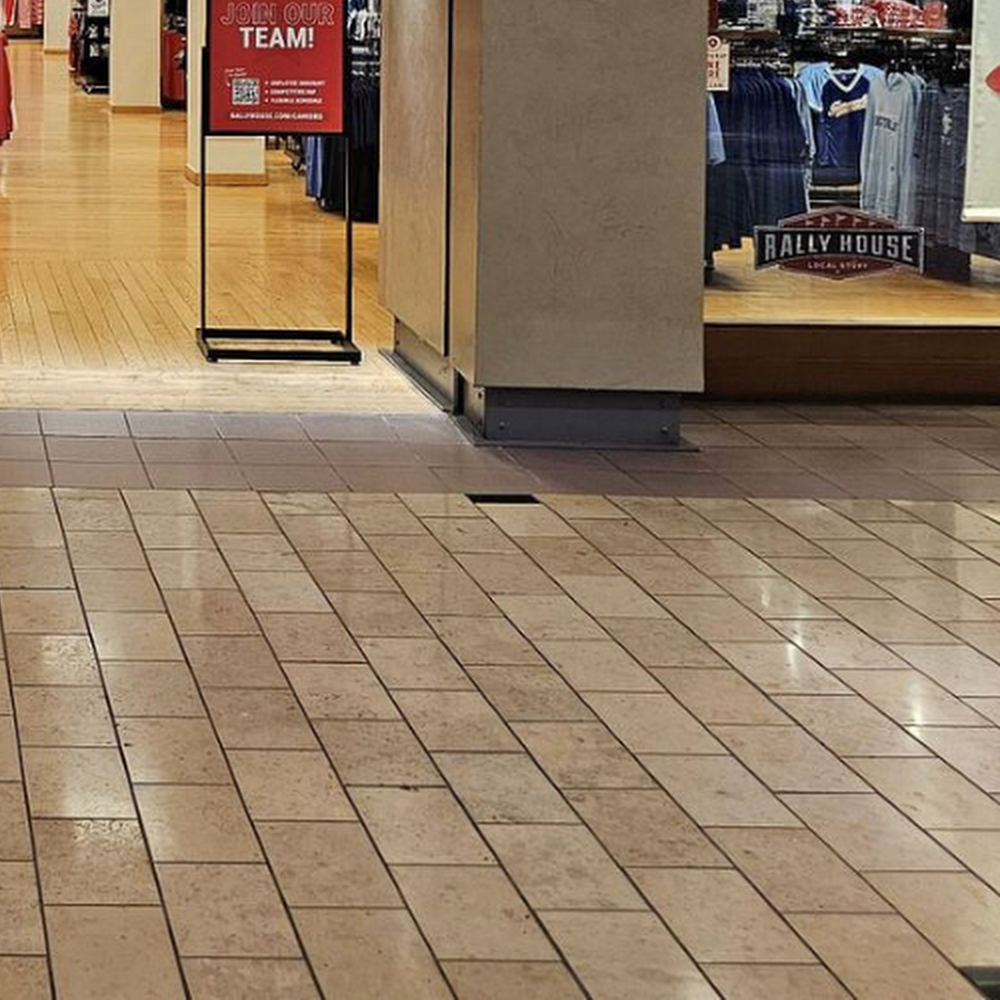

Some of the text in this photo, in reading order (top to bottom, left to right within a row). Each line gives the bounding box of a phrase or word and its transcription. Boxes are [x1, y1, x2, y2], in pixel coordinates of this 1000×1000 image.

[220, 1, 335, 26] JOIN OUR
[239, 26, 315, 49] TEAM!
[764, 233, 913, 263] RALLY HOUSE
